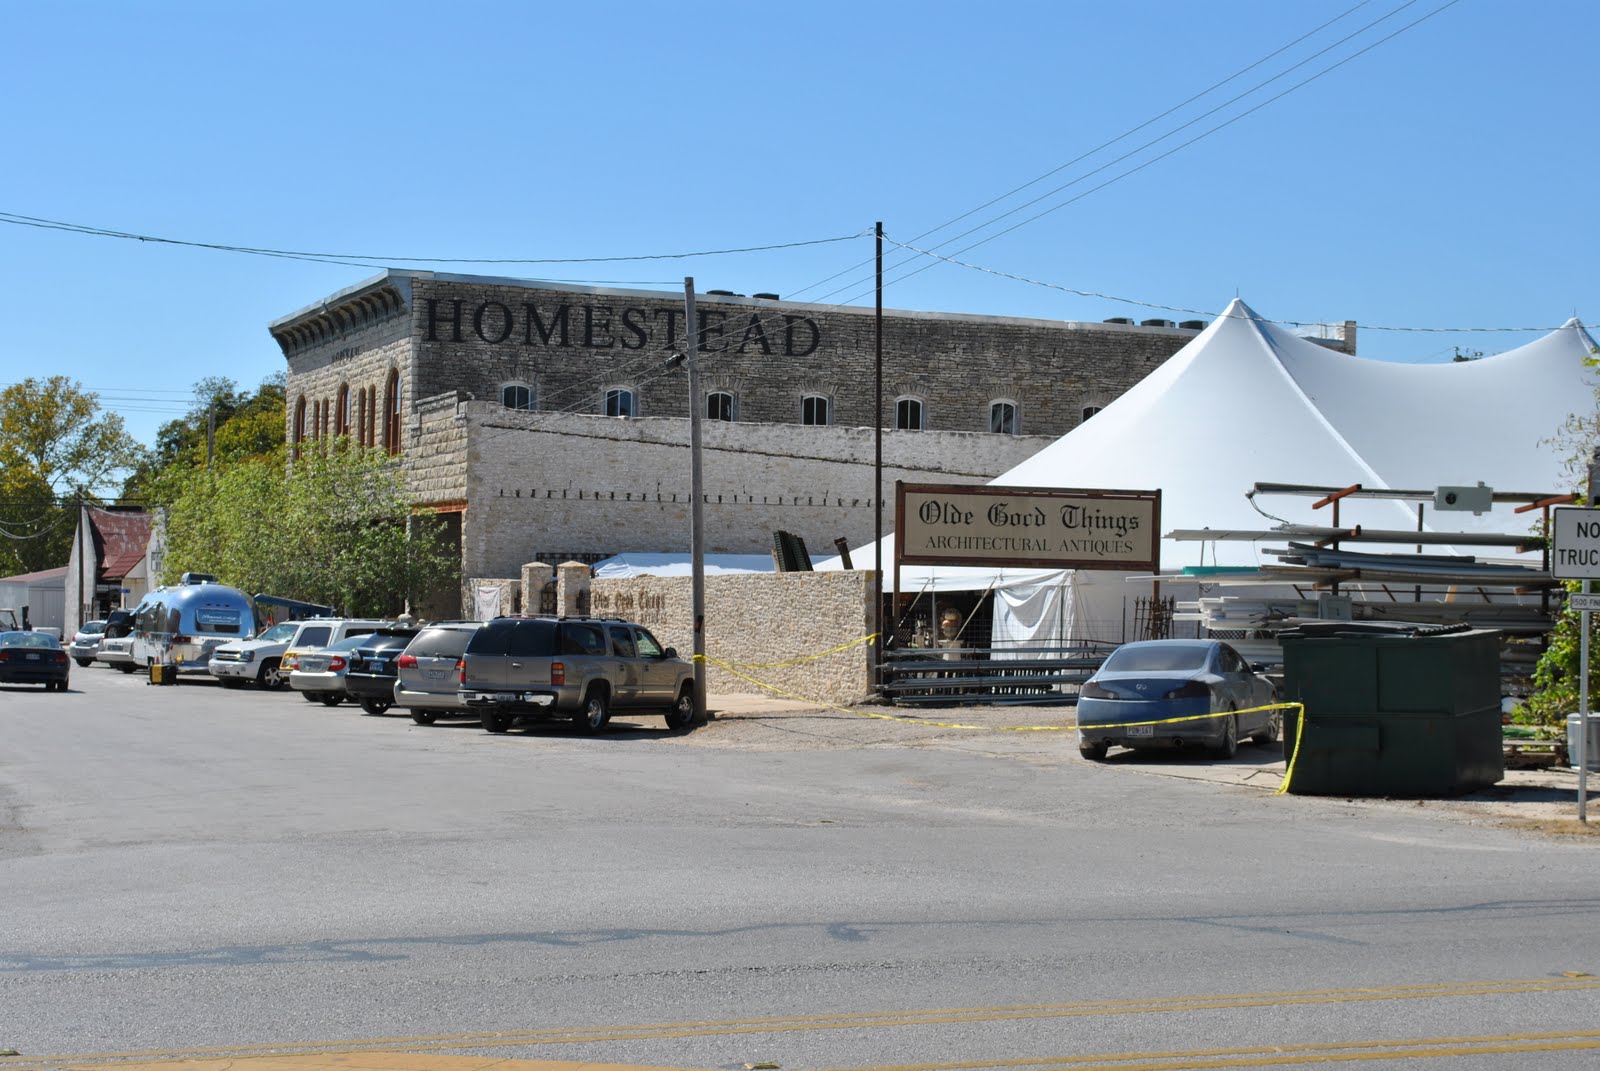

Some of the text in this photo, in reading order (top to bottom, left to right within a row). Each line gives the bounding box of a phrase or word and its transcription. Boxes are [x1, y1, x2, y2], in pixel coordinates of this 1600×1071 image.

[427, 299, 821, 357] HOMESTEAD
[919, 500, 1140, 538] Olde Good Things
[1577, 521, 1600, 539] NO
[925, 535, 1134, 556] ARCHITECTURAL ANTIQUES
